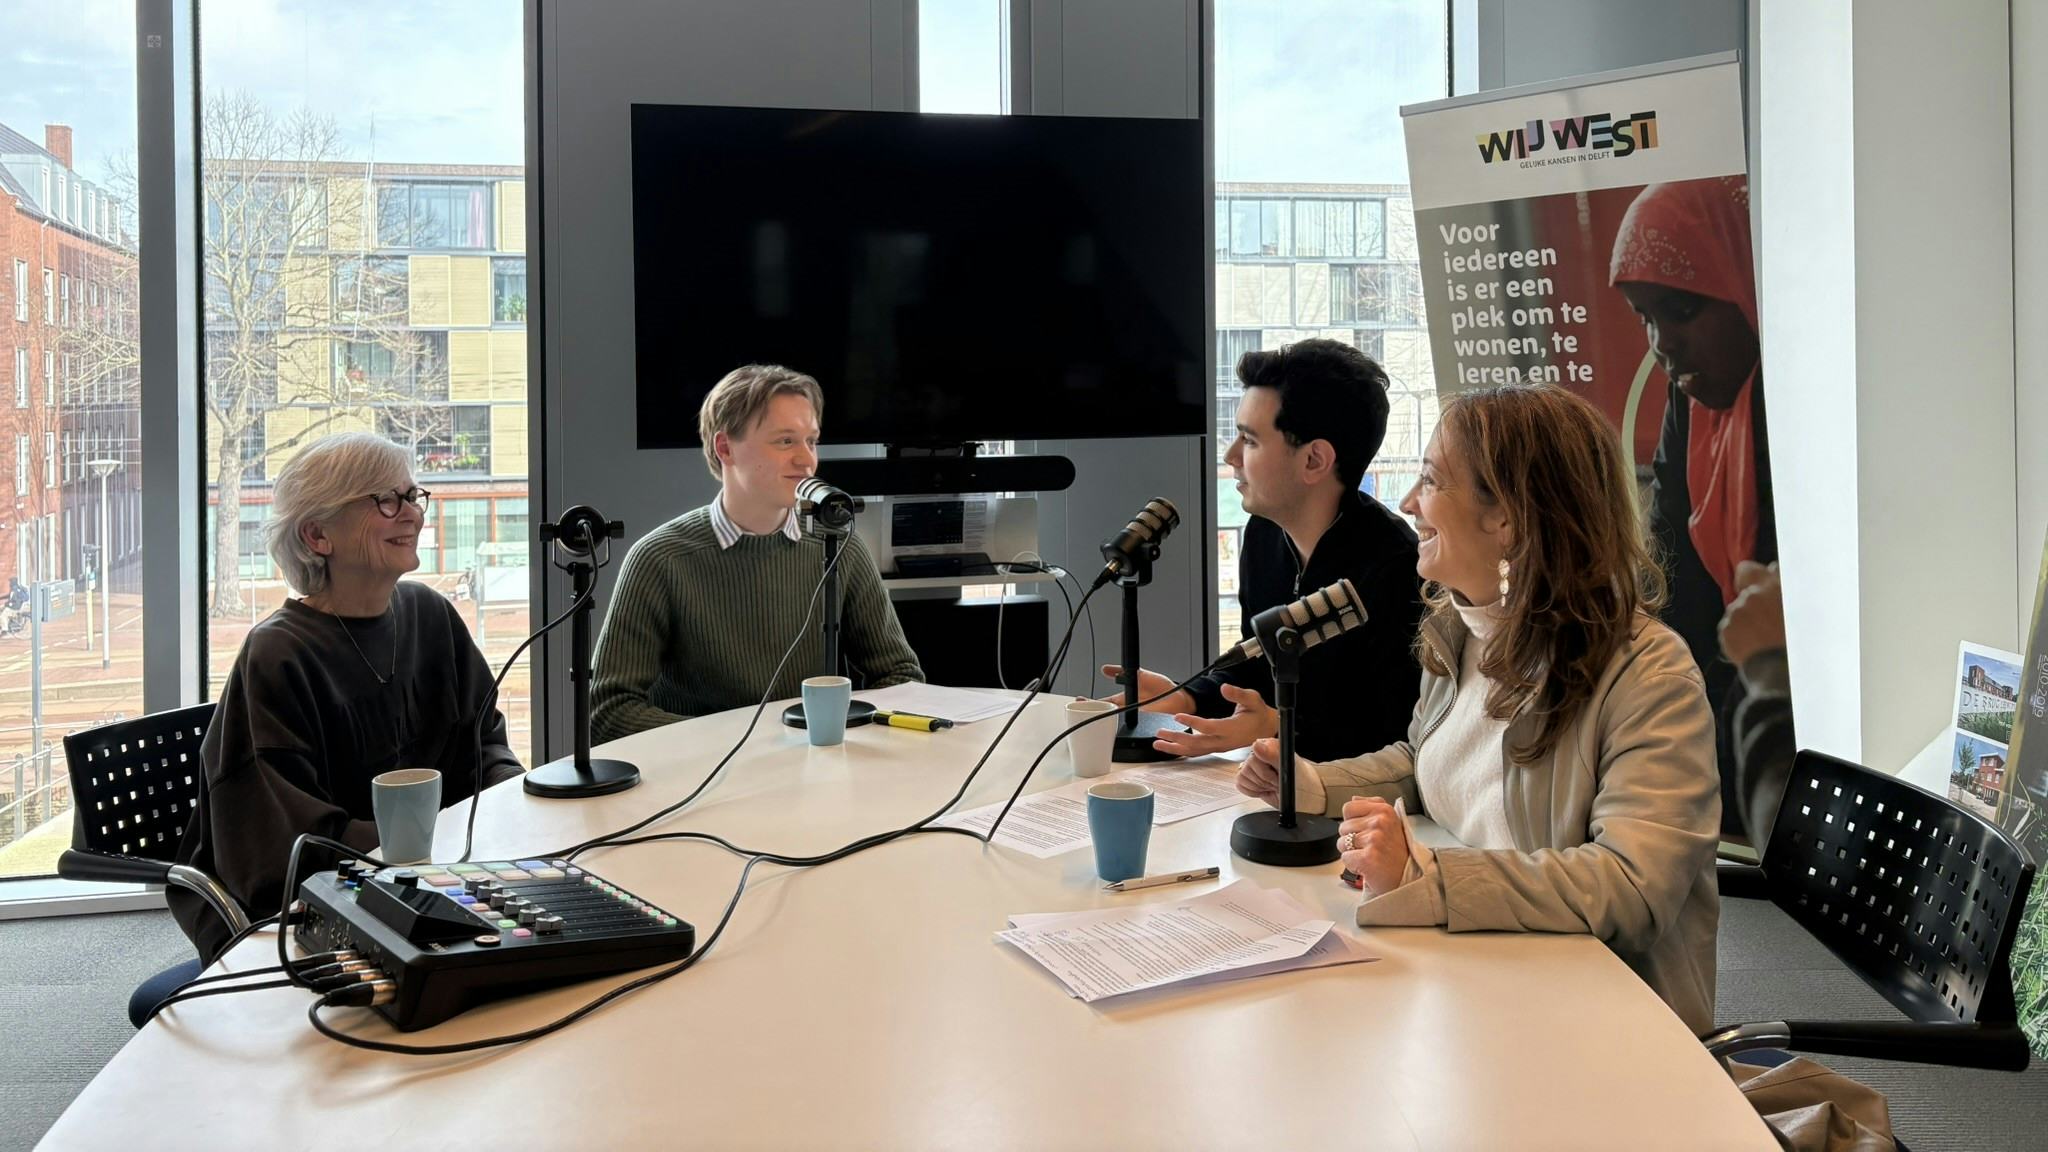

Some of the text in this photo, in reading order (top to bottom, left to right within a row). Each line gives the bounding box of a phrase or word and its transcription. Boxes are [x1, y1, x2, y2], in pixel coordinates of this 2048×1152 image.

[1477, 110, 1657, 164] WIJ WEST
[1547, 156, 1577, 165] KANSEN
[1578, 154, 1587, 162] IN
[1588, 151, 1610, 161] DELFT
[1439, 223, 1500, 245] Voor
[1443, 247, 1557, 274] iedereen
[1447, 277, 1554, 301] is er een
[1451, 302, 1587, 335] plek om te
[1453, 331, 1578, 358] wonen, te
[1457, 360, 1593, 384] leren en te
